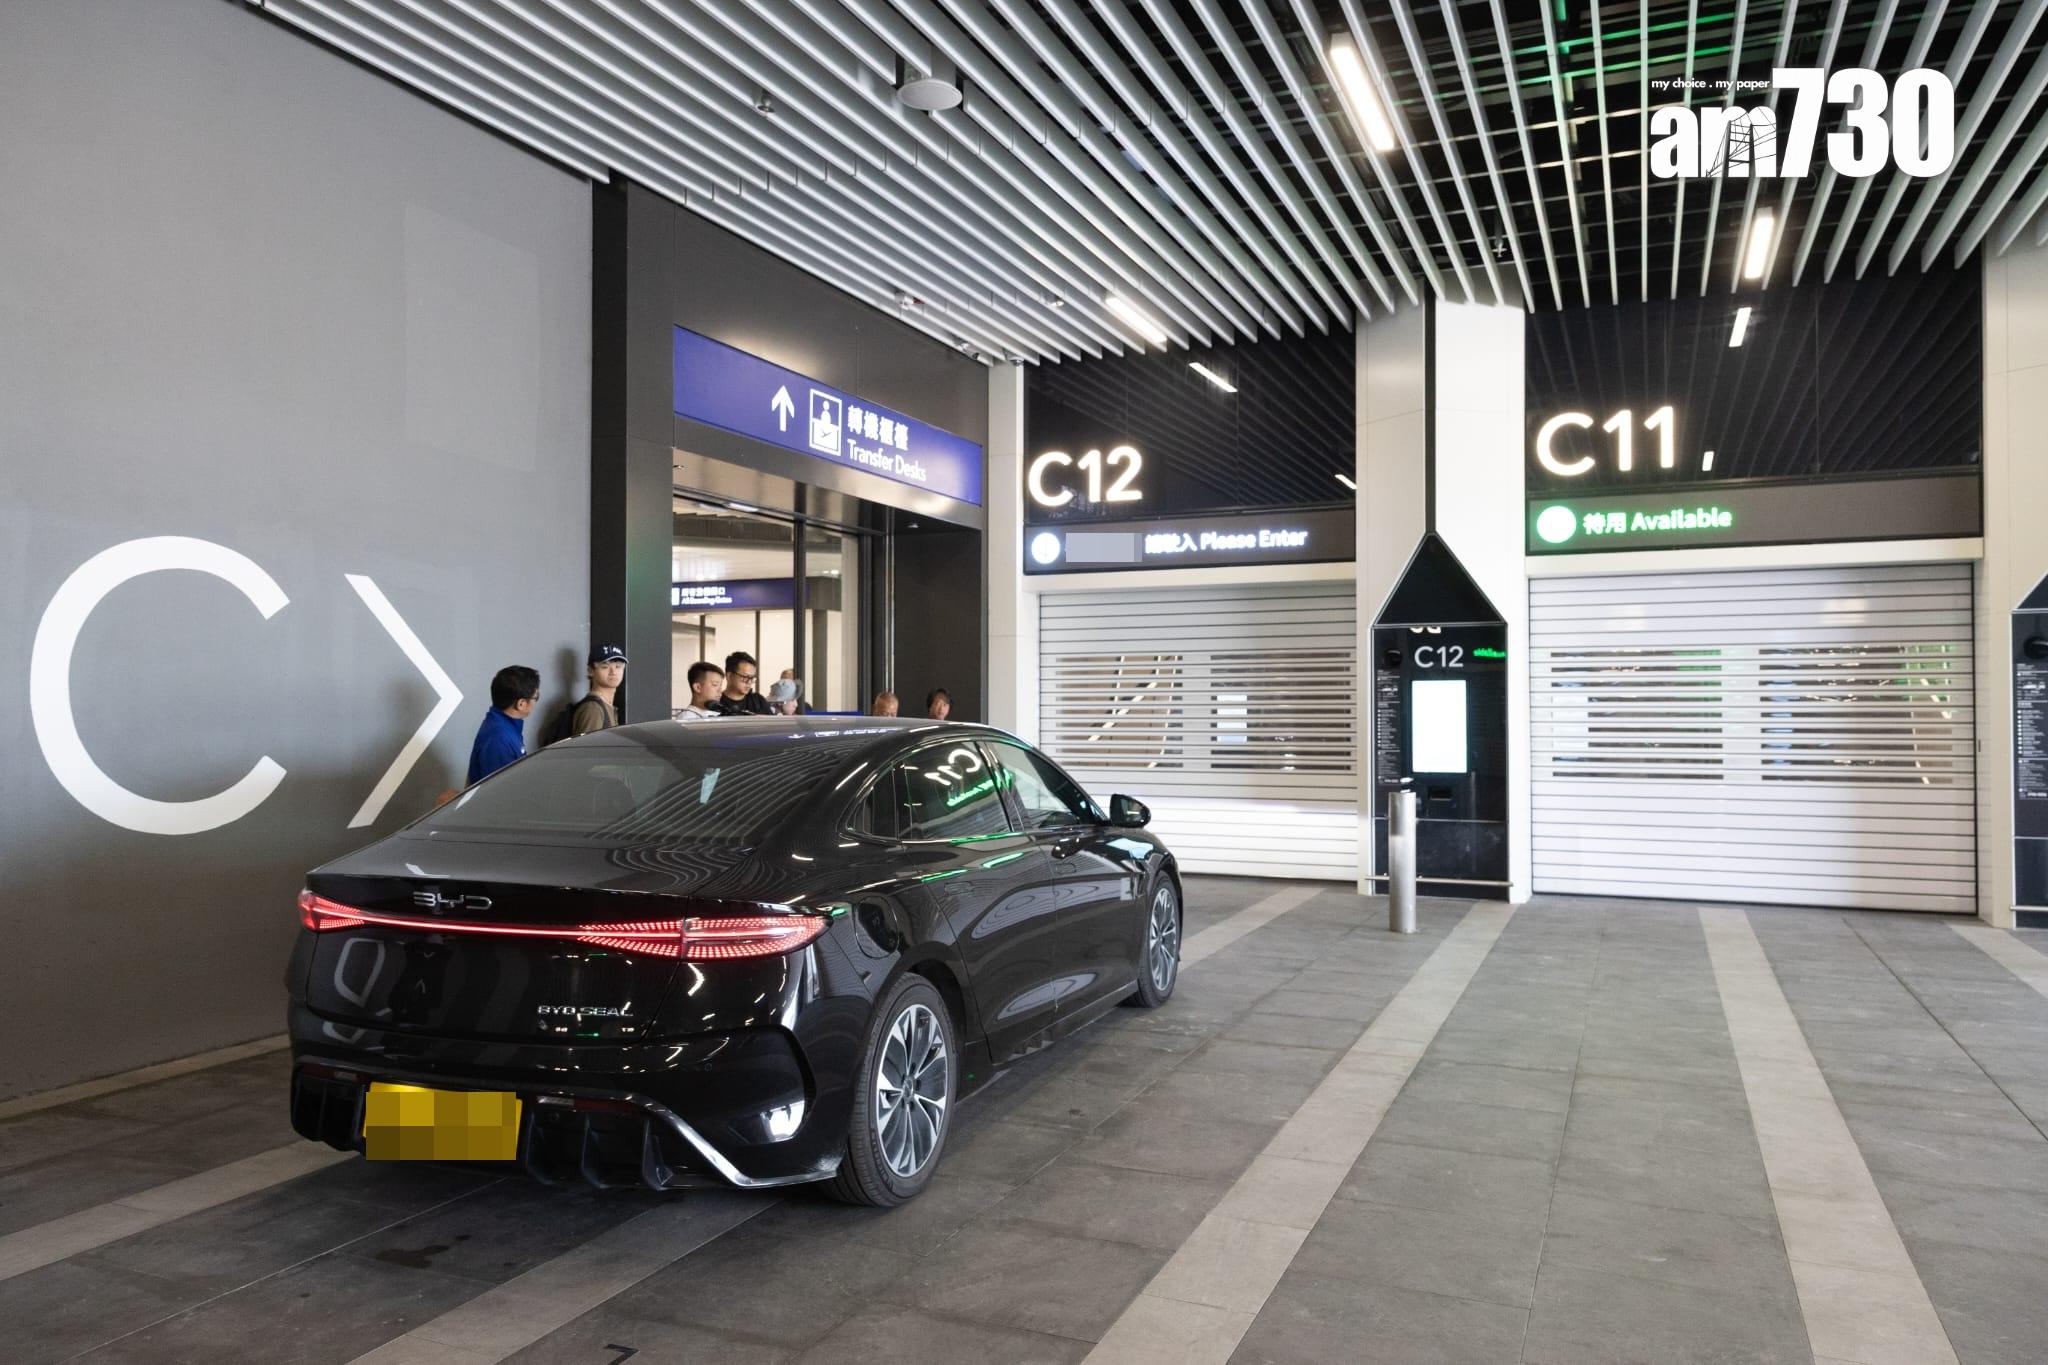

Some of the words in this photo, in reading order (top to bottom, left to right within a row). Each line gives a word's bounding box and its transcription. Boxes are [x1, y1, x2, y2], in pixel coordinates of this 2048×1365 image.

[1536, 405, 1675, 477] C11
[847, 438, 894, 472] Transfer
[894, 454, 927, 482] Desks
[1027, 445, 1143, 507] C12
[1630, 507, 1733, 532] Available
[1200, 531, 1257, 551] Please
[1258, 529, 1309, 548] Enter
[1414, 645, 1464, 668] C12
[413, 891, 493, 910] BYD
[579, 1006, 634, 1017] SEAL
